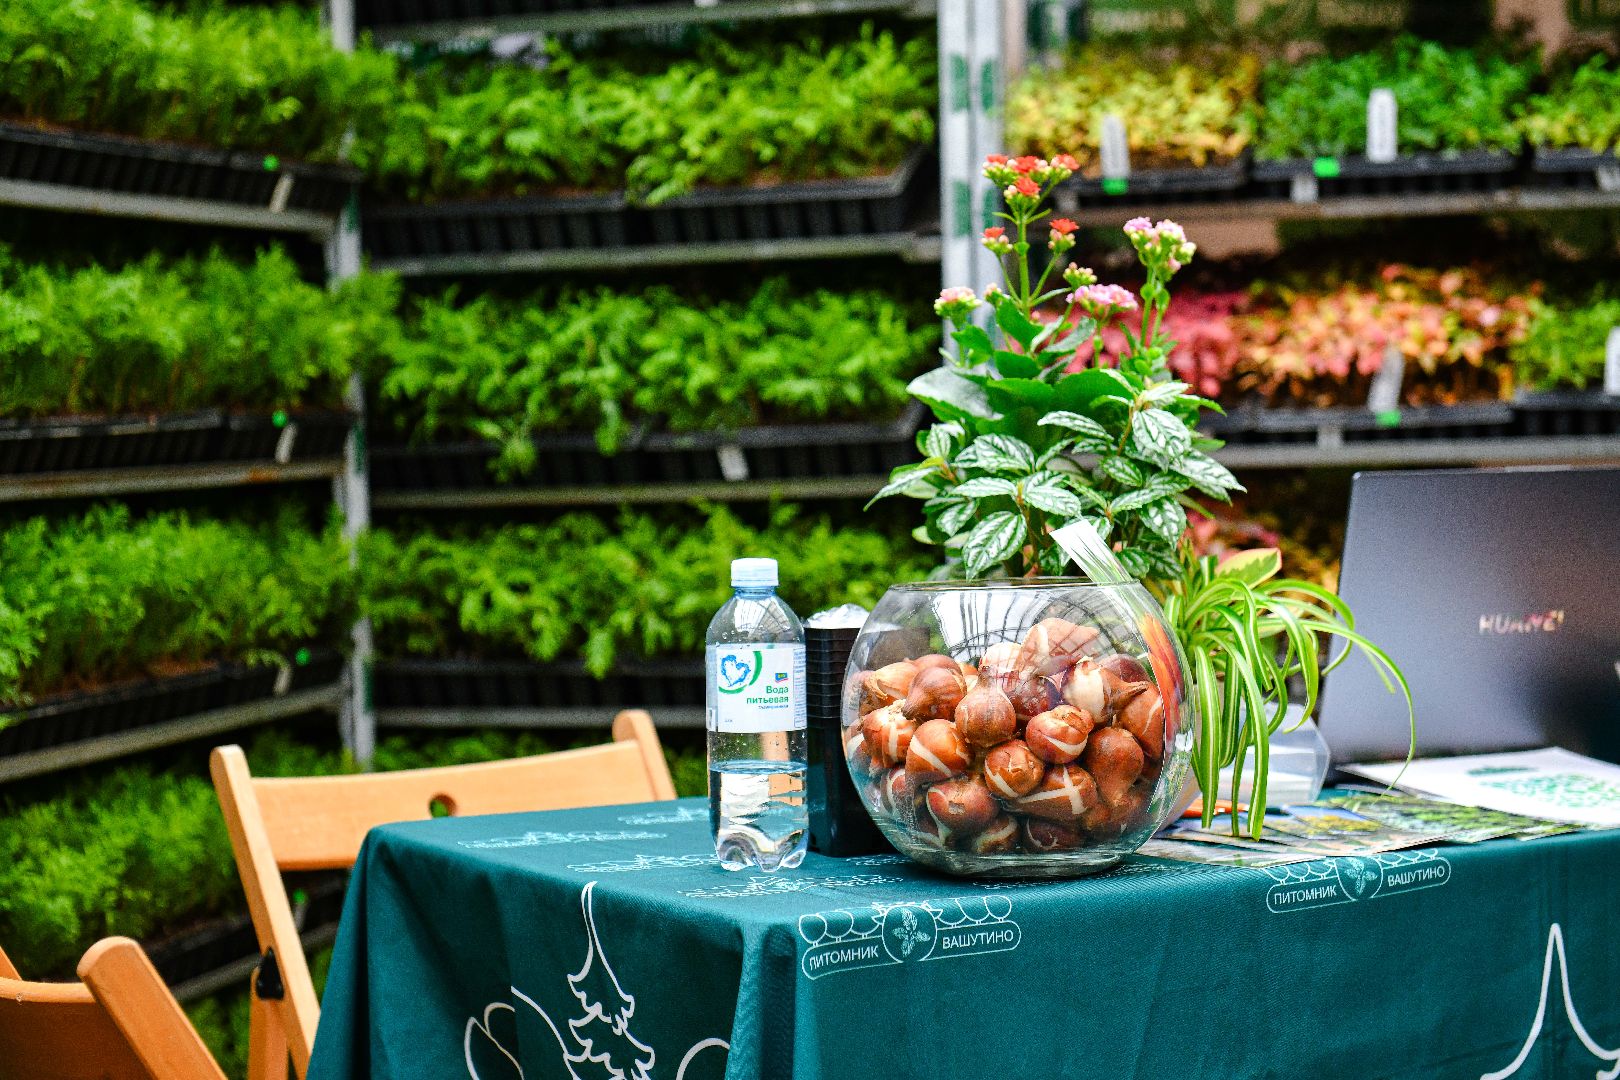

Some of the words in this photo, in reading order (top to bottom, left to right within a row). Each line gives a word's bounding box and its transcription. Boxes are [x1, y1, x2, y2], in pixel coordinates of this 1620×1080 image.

[746, 696, 789, 705] питьевая
[766, 685, 789, 695] Вода
[1274, 885, 1337, 905] ПИТОМНИК
[1387, 865, 1446, 888] ВАШУТИНО
[809, 945, 879, 971] ПИТОМНИК
[942, 929, 1014, 950] ВАШУТИНО
